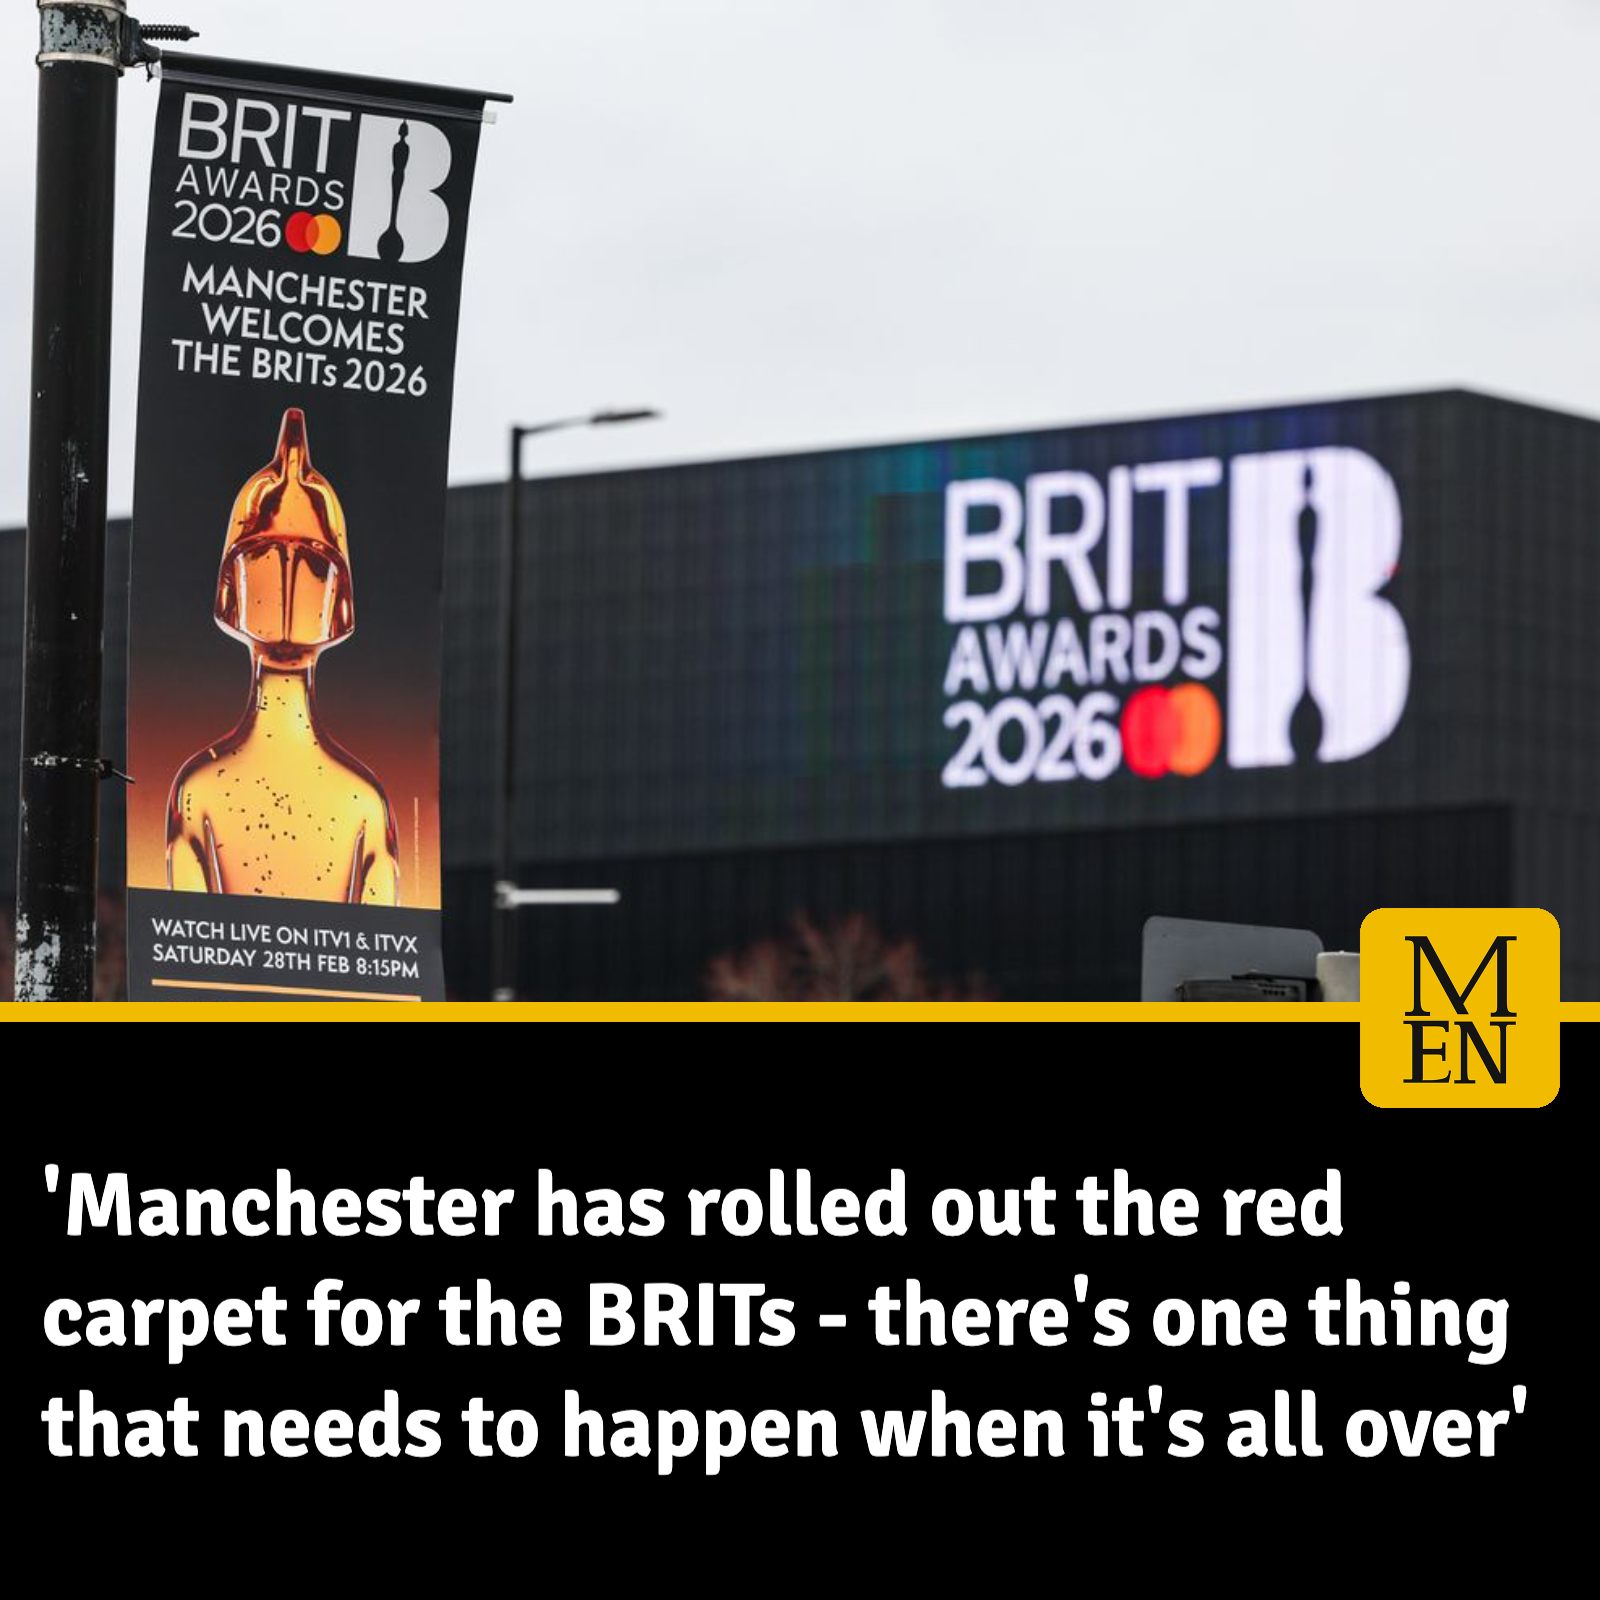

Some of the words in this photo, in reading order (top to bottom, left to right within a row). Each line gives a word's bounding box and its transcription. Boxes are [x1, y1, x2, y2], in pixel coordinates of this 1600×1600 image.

[178, 92, 352, 174] BRIT
[175, 164, 345, 211] AWARDS
[171, 200, 281, 247] 2026
[182, 261, 429, 319] MANCHESTER
[201, 302, 405, 355] WELCOMES
[171, 338, 241, 376] THE
[252, 347, 337, 387] BRITs
[343, 357, 428, 397] 2026
[943, 456, 1223, 625] BRIT
[943, 606, 1223, 696] AWARDS
[941, 691, 1123, 789] 2026
[151, 917, 225, 940] WATCH
[230, 923, 272, 943] LIVE
[276, 926, 309, 947] ON
[313, 929, 350, 949] ITV1
[355, 932, 370, 951] &
[374, 934, 418, 954] ITVX
[152, 943, 257, 967] SATURDAY
[263, 951, 311, 972] 28TH
[317, 955, 350, 974] FEB
[355, 959, 420, 979] 8:15PM
